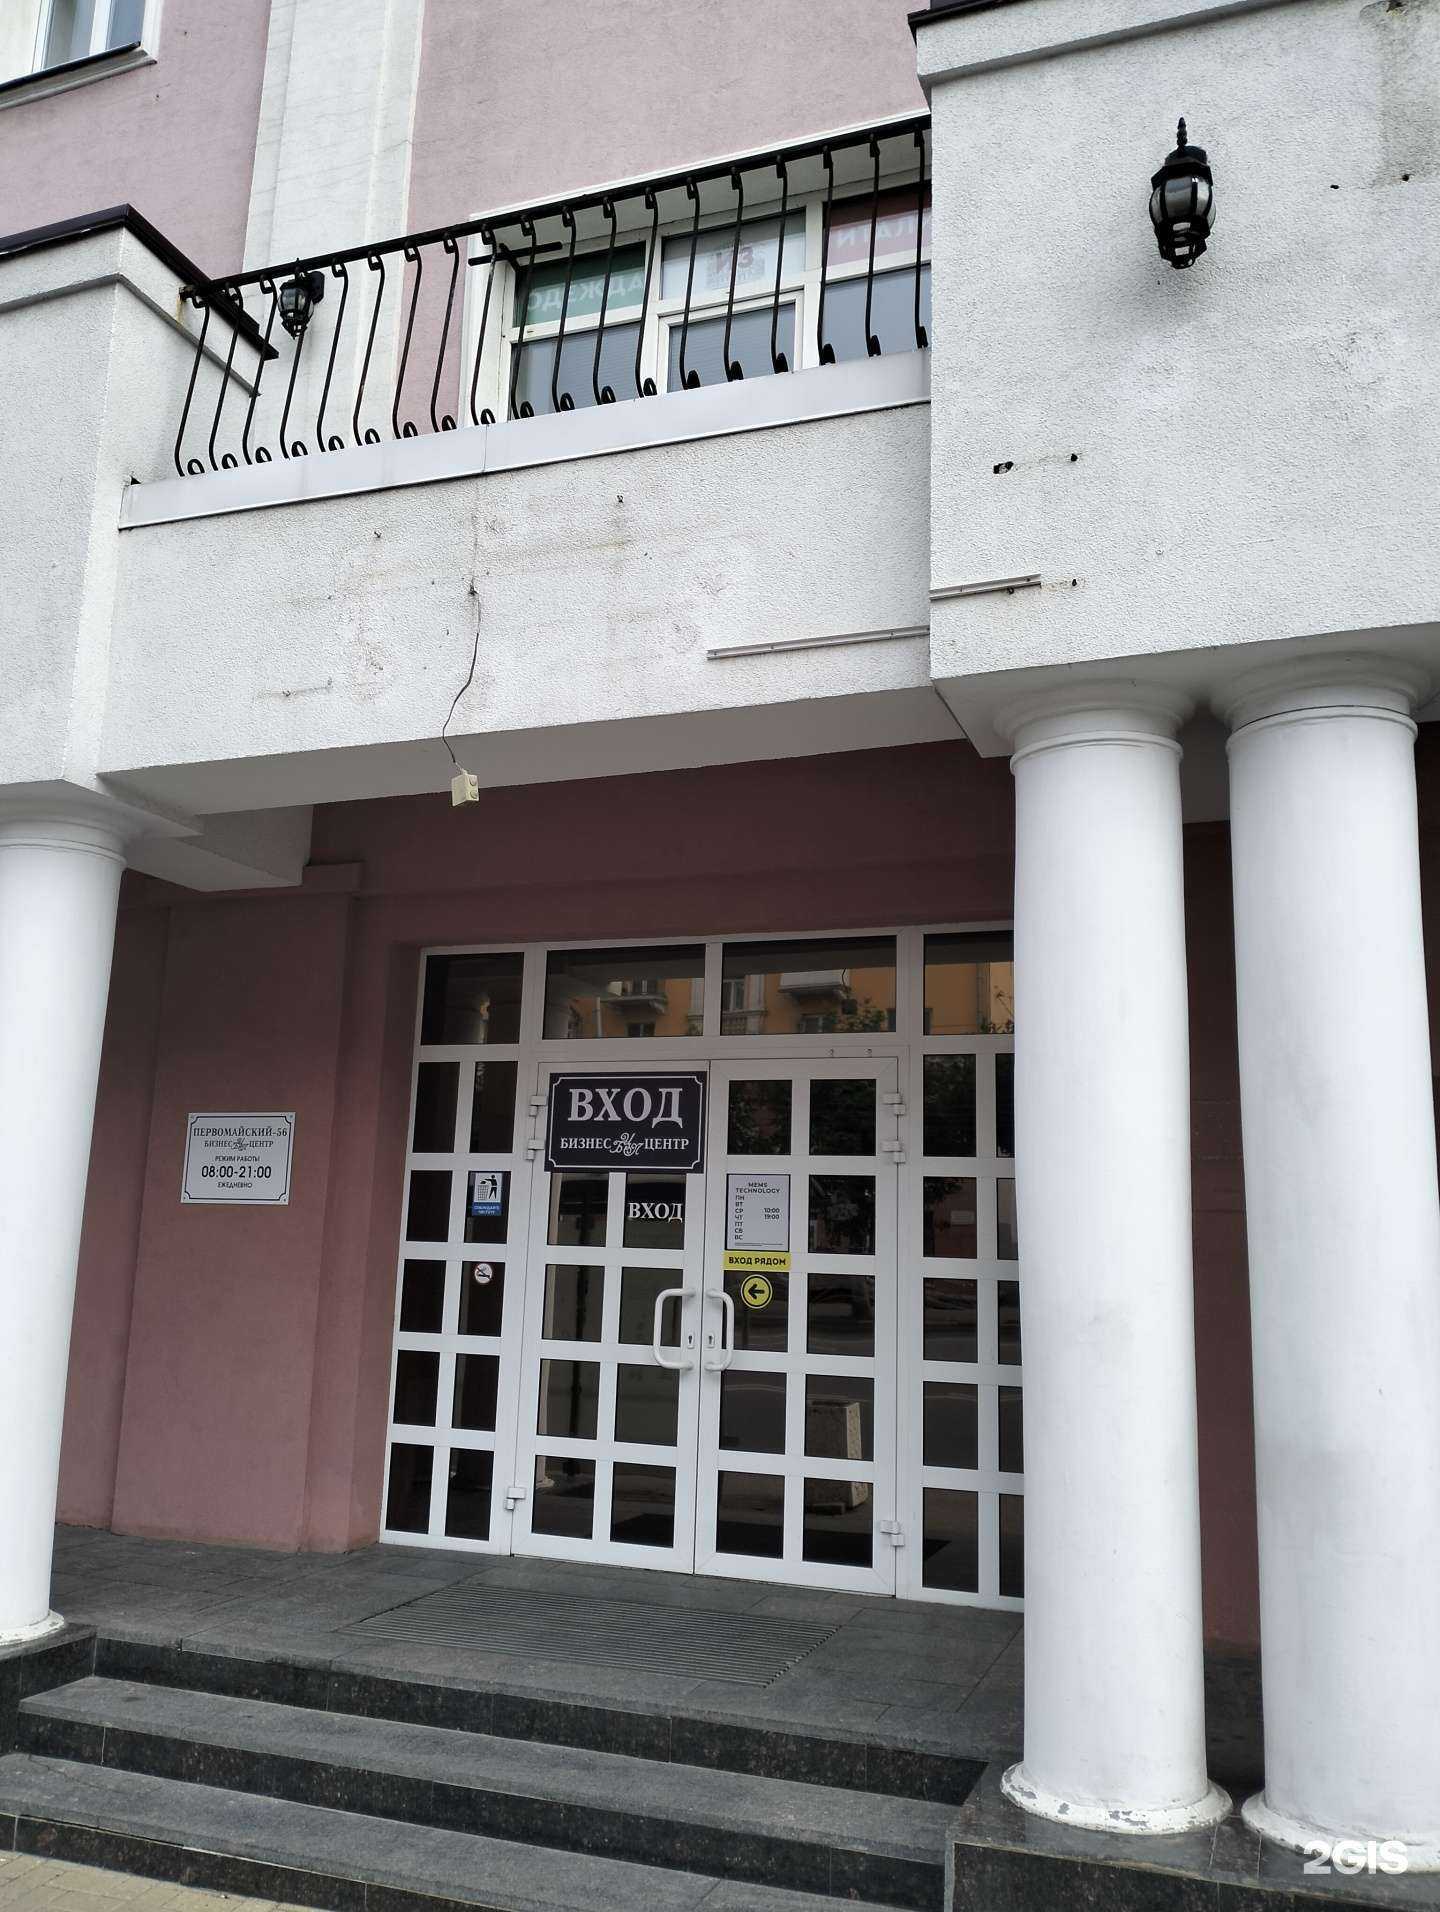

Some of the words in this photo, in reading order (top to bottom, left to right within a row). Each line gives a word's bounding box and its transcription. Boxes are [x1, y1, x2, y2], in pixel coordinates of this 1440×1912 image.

[567, 1087, 683, 1129] ВХОД
[193, 1125, 288, 1138] ПЕРВОМАЙСКИЙ-56
[204, 1140, 232, 1148] БИЗНЕС
[249, 1140, 274, 1149] ЦЕНТР
[560, 1137, 611, 1150] БИЗНЕС
[644, 1138, 690, 1151] ЦЕНТР
[201, 1165, 272, 1179] 08:00-21:00
[217, 1181, 253, 1189] ЕЖЕДНЕВНО
[628, 1202, 683, 1223] ВХОД
[728, 1256, 753, 1266] ВХОД
[754, 1256, 787, 1266] РЯДОМ
